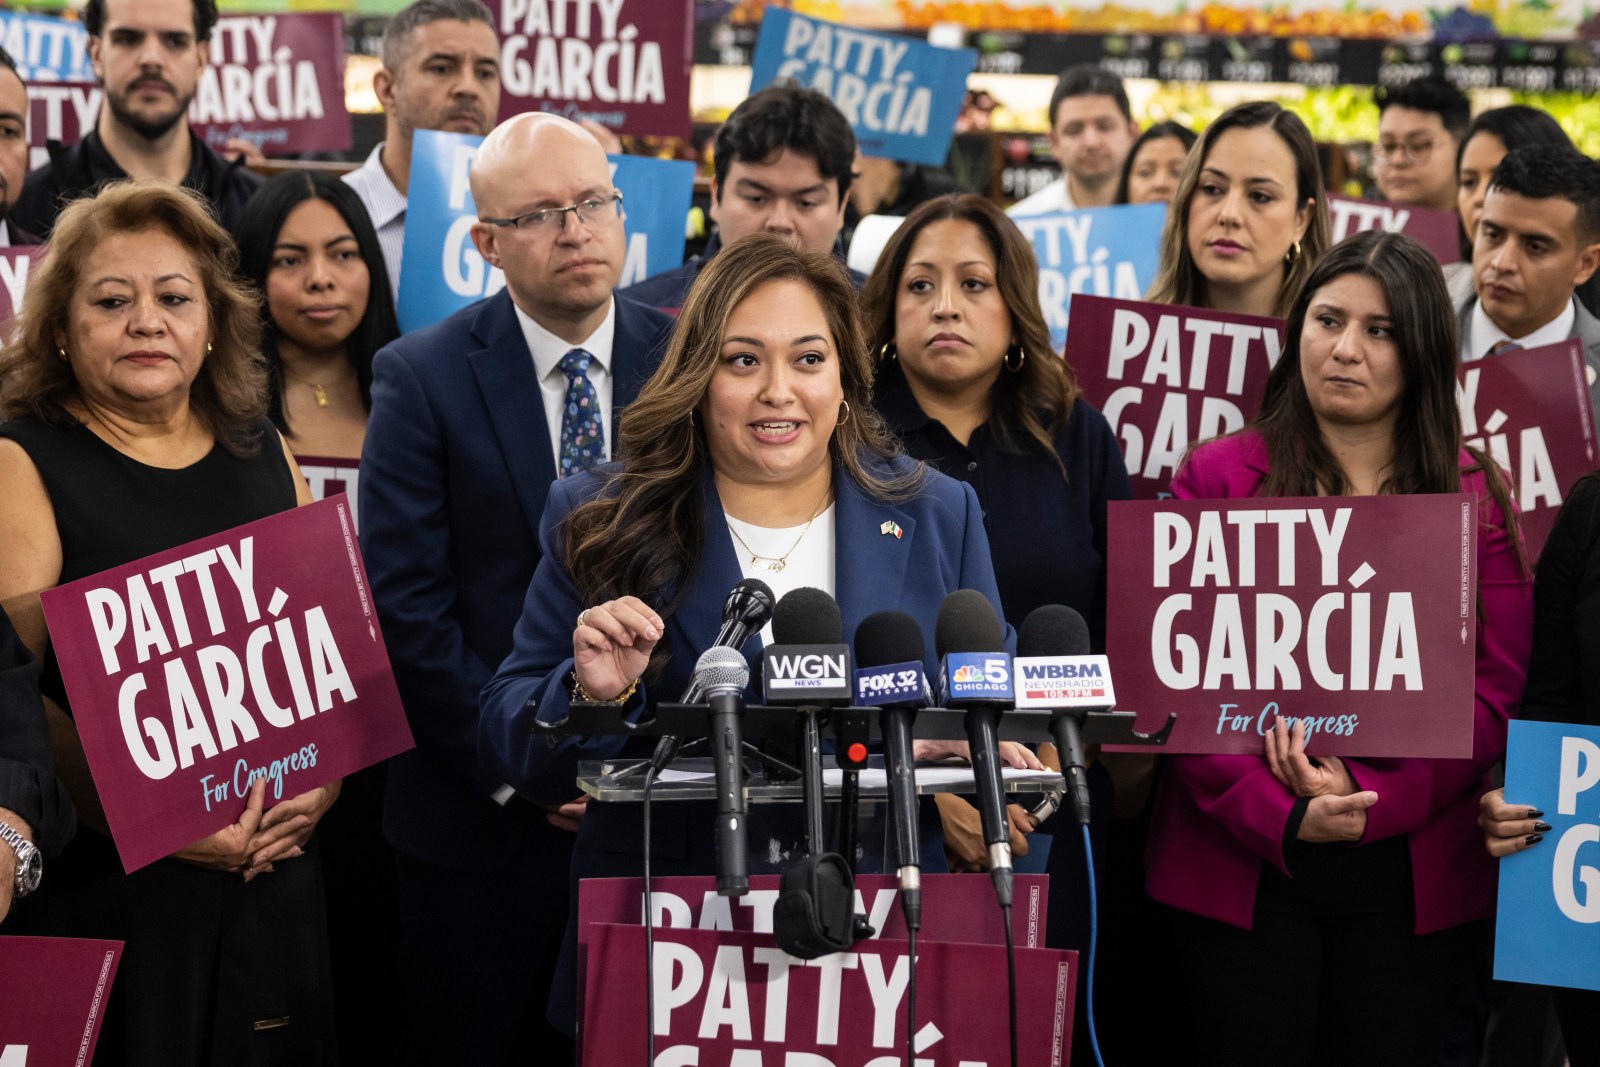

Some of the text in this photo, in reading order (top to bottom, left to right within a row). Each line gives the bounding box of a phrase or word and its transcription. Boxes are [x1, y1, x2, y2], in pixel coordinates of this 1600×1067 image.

[0, 15, 90, 68] ATTY
[211, 15, 277, 65] TTY
[501, 23, 667, 104] GARCÍA
[784, 16, 909, 80] PATTY
[190, 46, 324, 124] ARCÍA
[1013, 214, 1092, 266] TTY
[1037, 246, 1142, 329] RÍA
[1153, 508, 1352, 588] PATTY
[85, 536, 260, 675] PATTY
[1151, 561, 1423, 691] GARCÍA
[118, 587, 357, 780] GARCÍA
[770, 655, 845, 678] WGN
[859, 670, 917, 692] FOX 32
[860, 686, 918, 698] CHICAGO
[985, 659, 1008, 683] 5
[1023, 664, 1102, 679] WBBM
[1025, 680, 1104, 689] NEWSRADIO
[1043, 690, 1092, 698] 105.9FM
[1216, 702, 1360, 750] For Cngress
[200, 774, 230, 812] For
[653, 941, 918, 1048] PATTY
